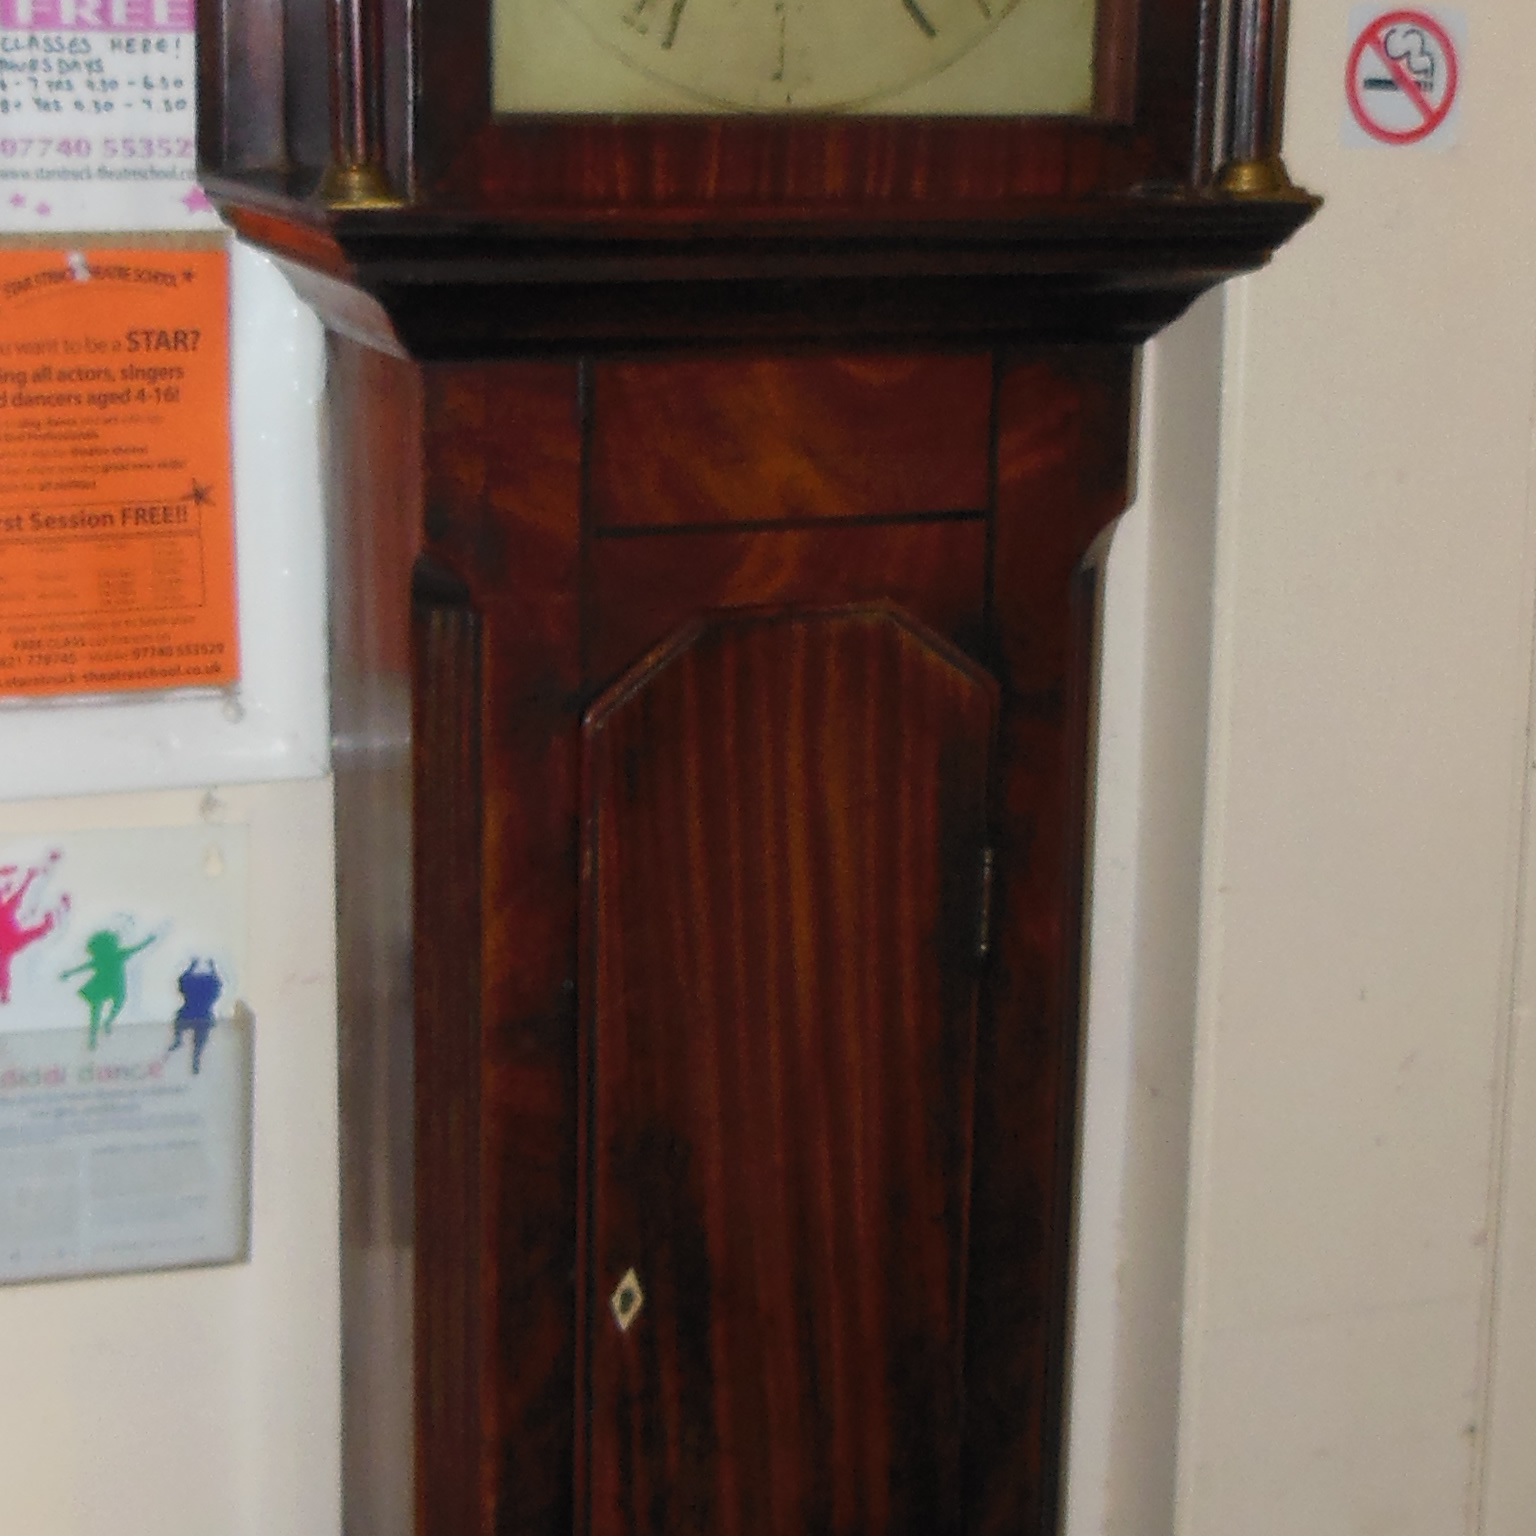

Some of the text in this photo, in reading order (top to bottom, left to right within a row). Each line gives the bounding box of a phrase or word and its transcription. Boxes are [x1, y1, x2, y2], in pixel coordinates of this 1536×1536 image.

[125, 326, 201, 353] STAR?
[120, 364, 185, 385] singers
[11, 390, 82, 407] dancers
[86, 387, 131, 409] aged
[29, 508, 115, 531] Session
